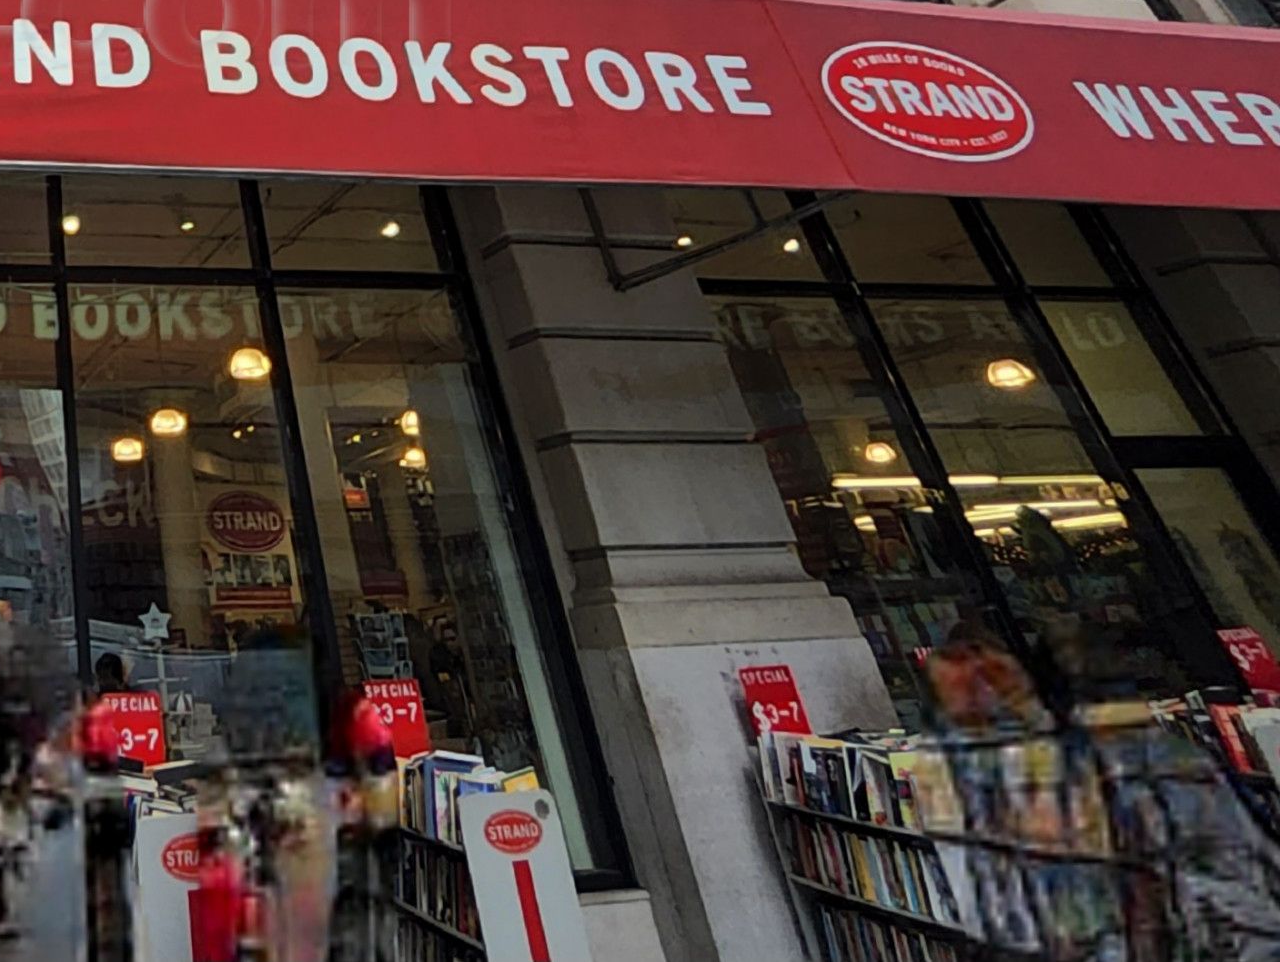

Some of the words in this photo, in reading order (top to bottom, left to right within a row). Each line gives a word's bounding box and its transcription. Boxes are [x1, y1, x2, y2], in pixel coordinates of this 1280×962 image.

[200, 28, 773, 116] BOOKSTORE
[840, 75, 1015, 122] STRAND
[33, 291, 383, 341] BOOKSTORE
[212, 510, 281, 532] STRAND
[364, 682, 418, 699] SPECIAL
[742, 668, 790, 686] SPECIAL
[752, 700, 800, 733] $3-7
[117, 727, 159, 756] 3-7
[487, 821, 539, 842] STRAND
